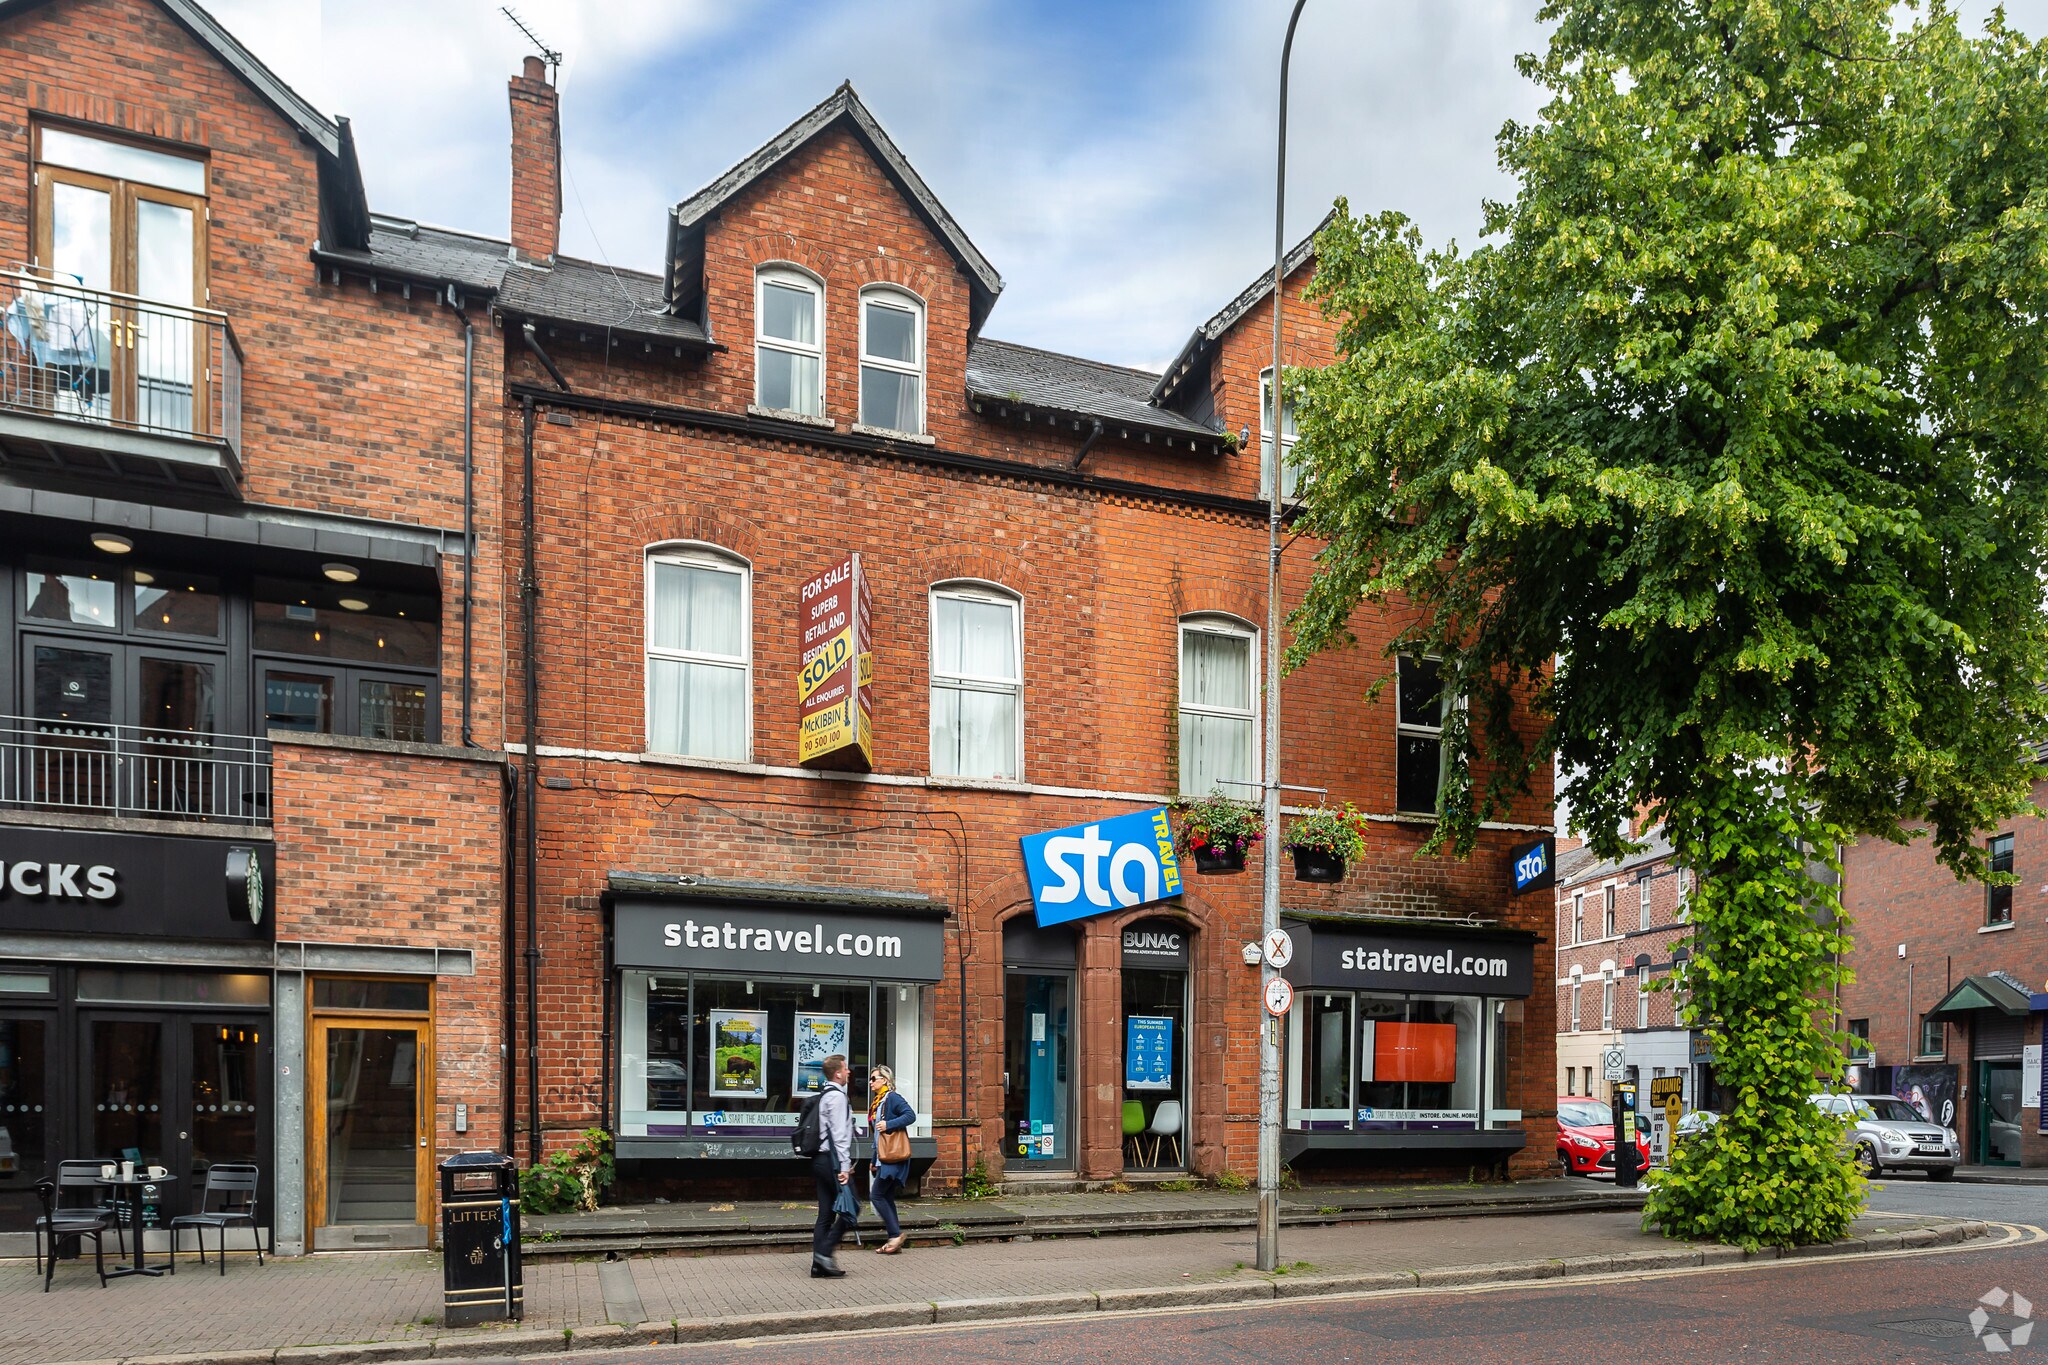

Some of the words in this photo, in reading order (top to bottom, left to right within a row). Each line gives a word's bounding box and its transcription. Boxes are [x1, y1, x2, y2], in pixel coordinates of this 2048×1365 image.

[802, 578, 822, 603] FOR
[823, 561, 850, 590] SALE
[811, 594, 838, 620] SUPERB
[805, 621, 828, 644] RETAIL
[829, 612, 845, 631] AND
[803, 638, 846, 692] SOLD
[806, 698, 816, 708] ALL
[816, 684, 845, 704] ENQUIRIES
[804, 707, 841, 735] McKIBBIN
[804, 740, 813, 752] 90
[814, 735, 828, 748] 500
[829, 729, 841, 743] 100
[1040, 824, 1160, 908] sta
[1151, 809, 1181, 893] TRAVEL
[1517, 853, 1543, 882] sta
[0, 860, 117, 899] CKS
[663, 919, 902, 958] statravel.com
[1123, 931, 1180, 950] BUNAC
[1341, 946, 1508, 978] statravel.com
[1652, 1077, 1681, 1094] BOTANIC
[705, 1113, 723, 1126] sta
[728, 1114, 744, 1123] START
[745, 1114, 756, 1123] THE
[757, 1114, 787, 1124] ADVENTURE
[1359, 1110, 1372, 1120] sta
[1375, 1111, 1387, 1119] START
[1387, 1111, 1395, 1119] THE
[1395, 1111, 1417, 1120] ADVENTURE
[1653, 1113, 1665, 1121] LOCKS
[452, 1210, 497, 1223] LITTER
